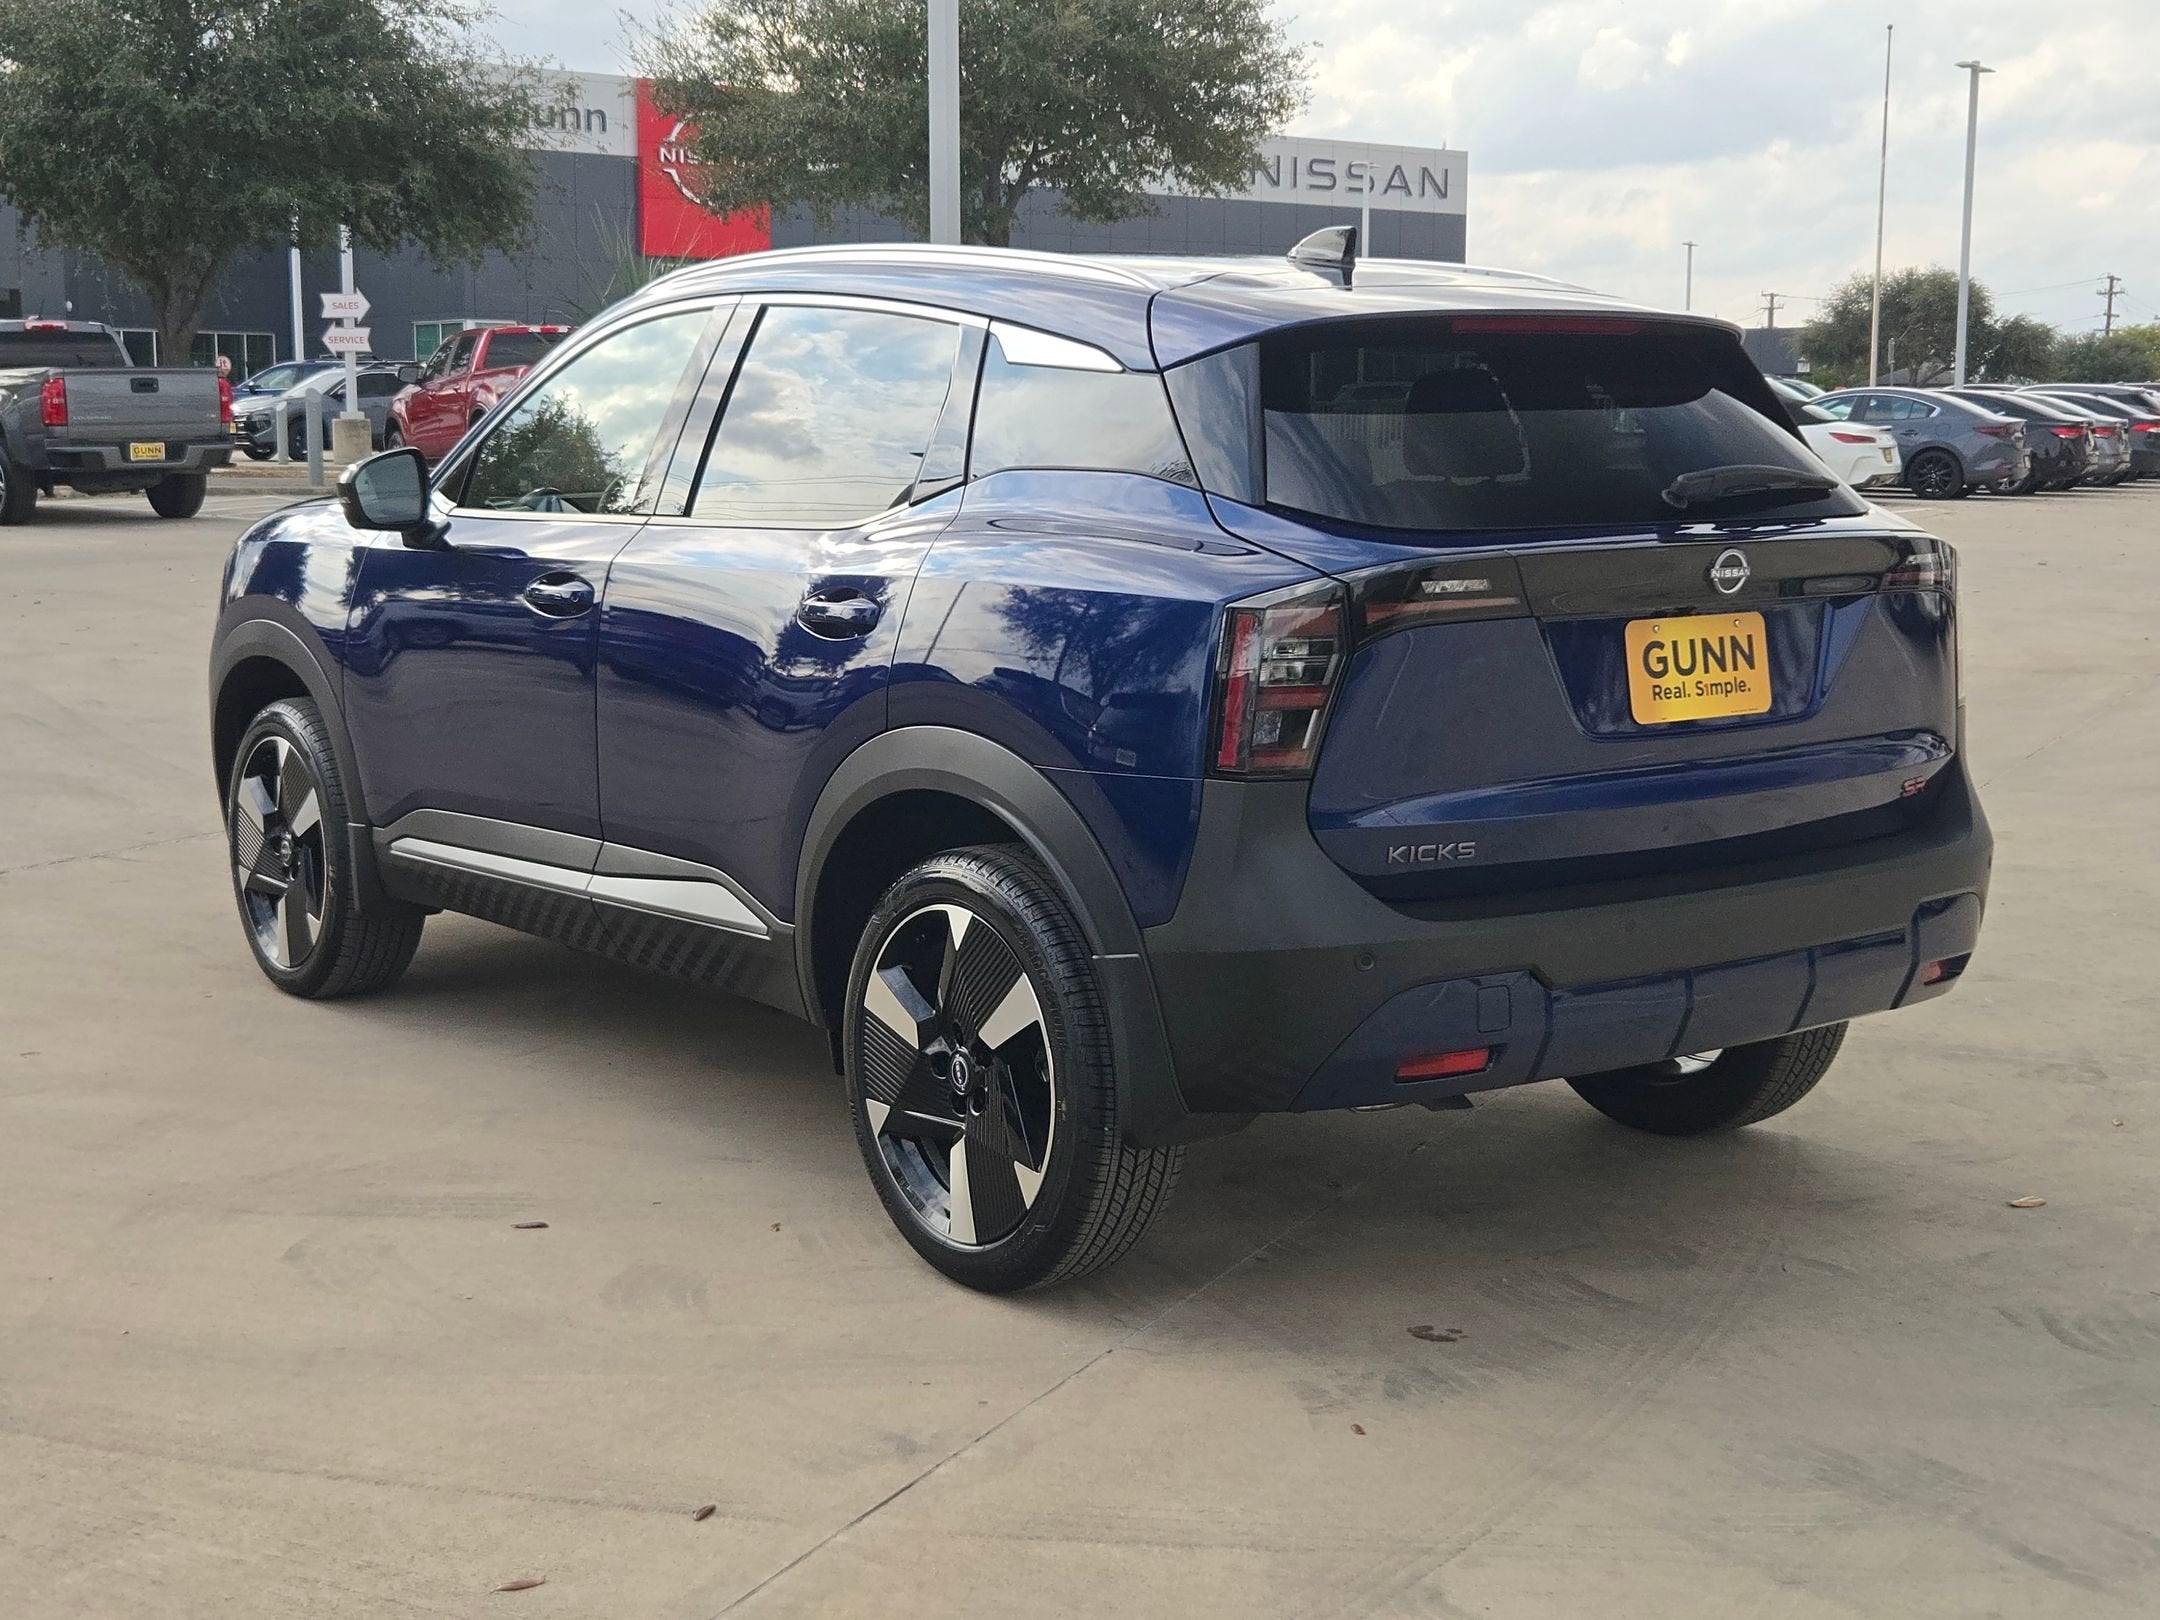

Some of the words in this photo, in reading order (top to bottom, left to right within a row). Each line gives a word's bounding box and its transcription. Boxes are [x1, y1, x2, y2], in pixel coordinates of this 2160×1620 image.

[514, 104, 607, 134] unn
[1250, 154, 1449, 200] NISSAN
[332, 302, 360, 310] SALES
[328, 336, 366, 344] SERVICE
[133, 446, 162, 455] GUNN
[1711, 567, 1750, 578] NISSAN
[1642, 633, 1756, 679] GUNN
[1652, 681, 1691, 701] Real.
[1903, 776, 1927, 797] SR
[1387, 841, 1477, 864] KICKS
